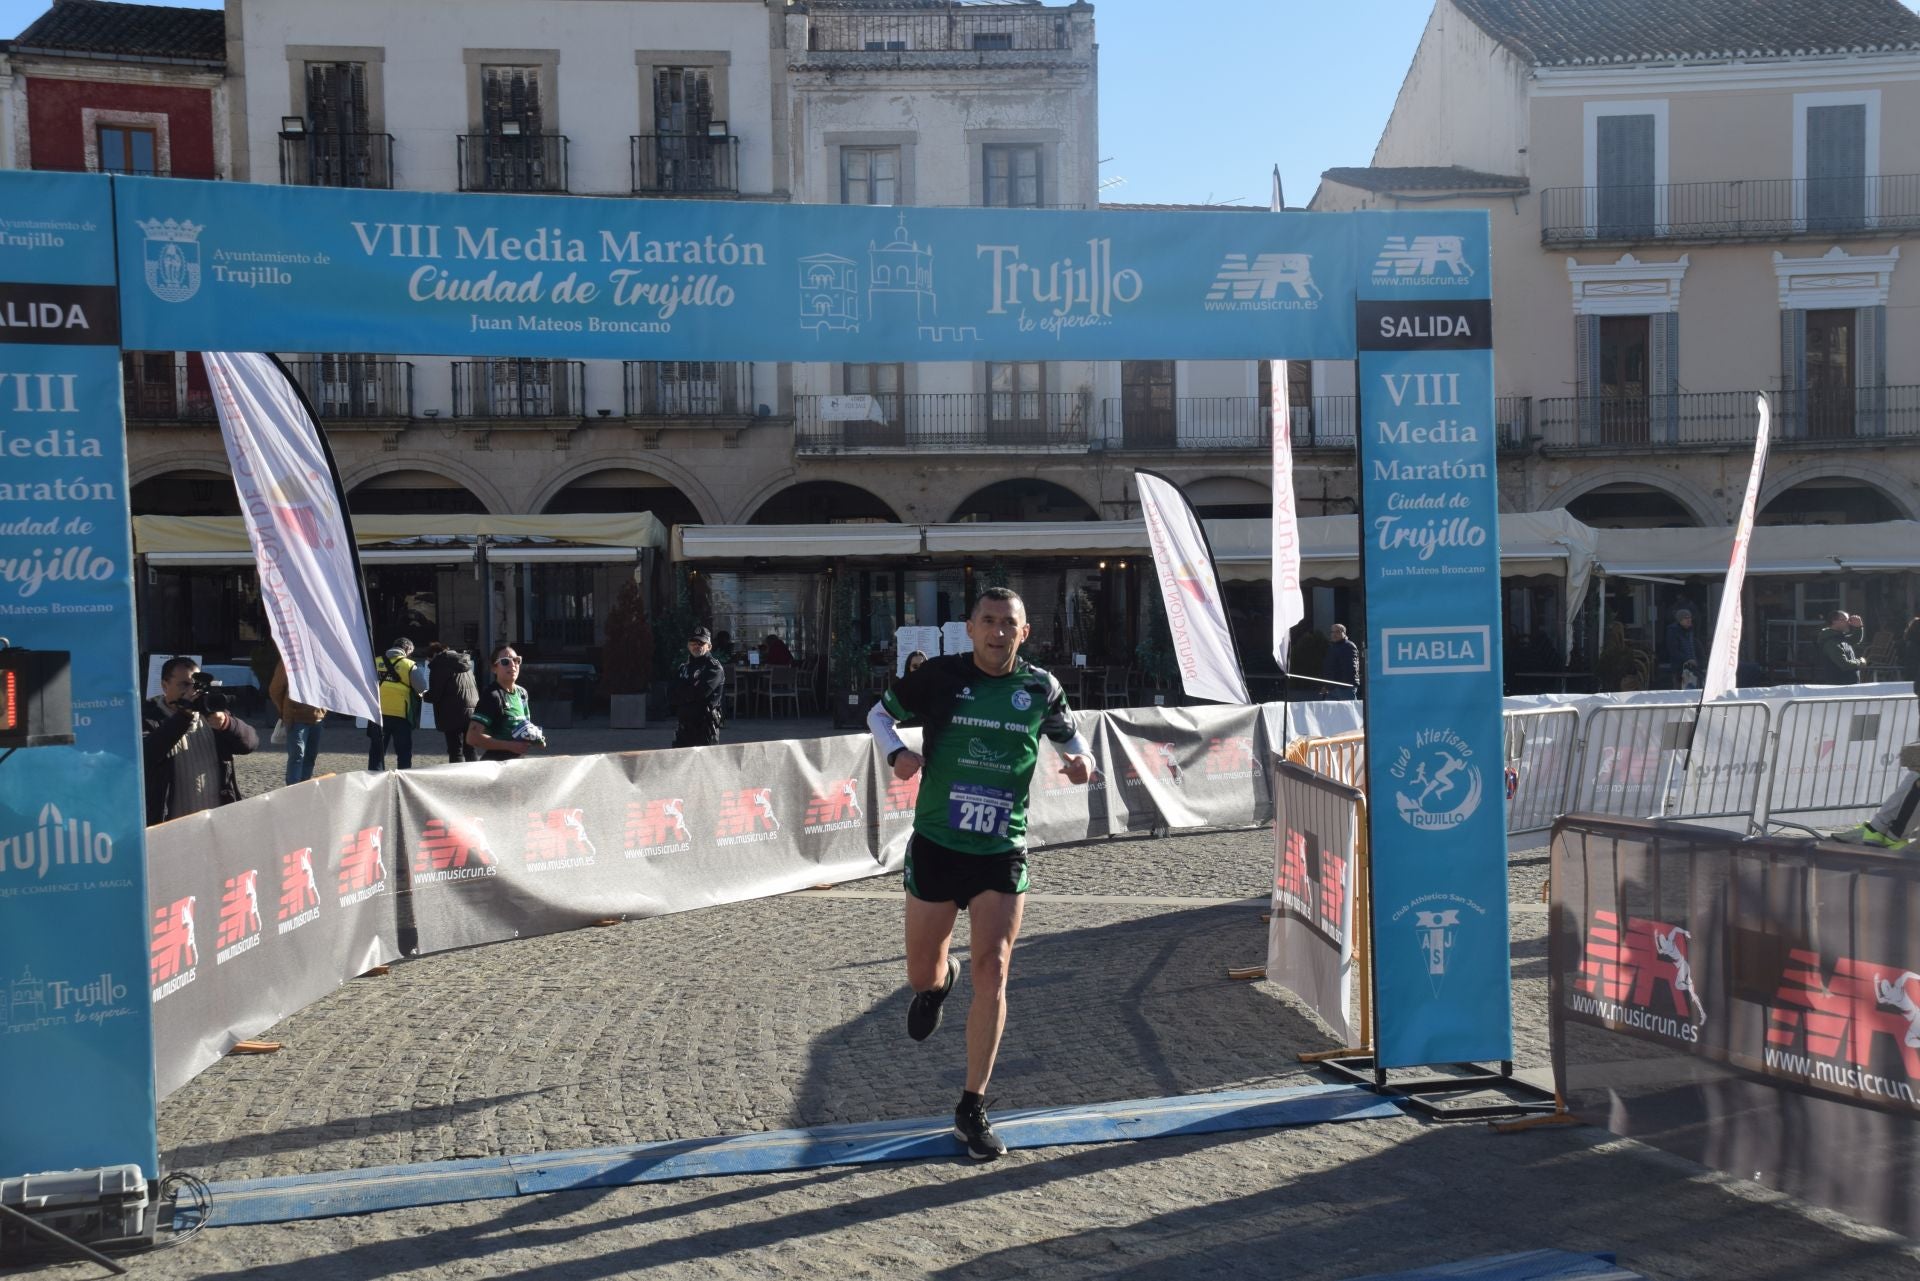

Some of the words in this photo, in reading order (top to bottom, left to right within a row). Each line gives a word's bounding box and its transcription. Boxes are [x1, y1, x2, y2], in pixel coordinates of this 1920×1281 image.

[82, 221, 97, 231] de
[350, 222, 441, 257] VIII
[454, 226, 587, 262] Media
[599, 230, 766, 265] Maratón
[212, 248, 310, 265] Ayuntamiento
[313, 252, 331, 265] de
[212, 265, 292, 288] Trujillo
[976, 238, 1143, 317] Trujillo
[1372, 276, 1470, 286] www.musicrun.es
[408, 265, 545, 303] Ciudad
[552, 271, 600, 303] de
[608, 268, 735, 319] Trujillo
[1204, 300, 1319, 311] www.musicrun.es
[470, 314, 513, 332] Juan
[518, 315, 583, 332] Mateos
[588, 316, 671, 333] Broncano
[1018, 308, 1036, 332] te
[1380, 315, 1472, 338] SALIDA
[1381, 373, 1460, 407] VIII
[1377, 420, 1479, 445] Media
[1373, 459, 1487, 481] Maratón
[1387, 491, 1445, 511] Ciudad
[1449, 492, 1471, 509] de
[64, 516, 96, 535] de
[1374, 515, 1487, 561] Trujillo
[1381, 567, 1404, 578] Juan
[1406, 566, 1439, 576] Mateos
[1441, 564, 1486, 575] Broncano
[0, 604, 48, 615] Mateos
[52, 603, 114, 614] Broncano
[1397, 640, 1475, 661] HABLA
[952, 715, 1001, 729] ATLETISMO
[1390, 745, 1412, 779] Club
[1416, 728, 1473, 758] Atletismo
[805, 819, 861, 835] www.musicrun.es
[959, 802, 997, 833] 213
[1404, 808, 1464, 826] TRUJILLO
[716, 830, 778, 847] www.musicrun.es
[624, 842, 690, 859] www.musicrun.es
[414, 864, 497, 884] www.musicrun.es
[526, 855, 596, 873] www.musicrun.es
[22, 883, 79, 895] COMIENCE
[84, 881, 96, 890] LA
[100, 880, 133, 888] MAGIA
[339, 880, 385, 908] www.musicrun.es
[1392, 904, 1410, 921] Club
[1449, 893, 1466, 904] San
[278, 906, 320, 935] www.musicrun.es
[217, 934, 260, 966] www.musicrun.es
[48, 973, 127, 1009] Trujillo
[75, 1008, 88, 1023] te
[1572, 993, 1698, 1043] www.musicrun.es
